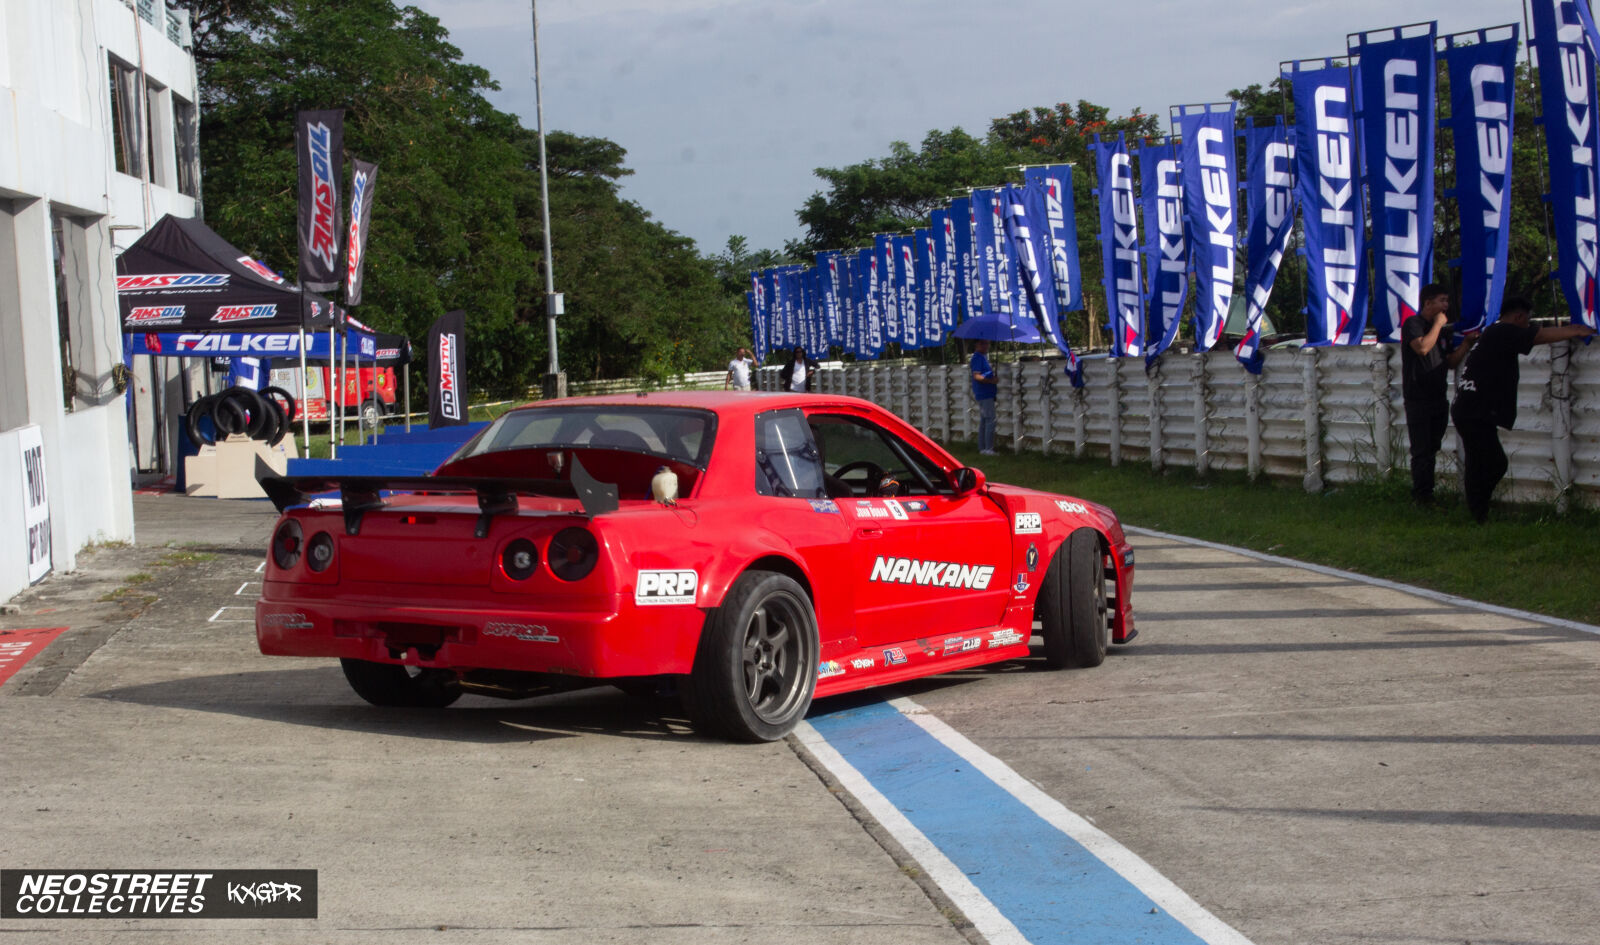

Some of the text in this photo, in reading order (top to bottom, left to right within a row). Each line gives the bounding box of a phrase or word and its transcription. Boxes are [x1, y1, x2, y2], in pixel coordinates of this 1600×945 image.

[307, 122, 337, 271] AMSOIL
[1314, 85, 1357, 347] FALKEN
[1384, 58, 1419, 340] FALKEN
[1046, 174, 1071, 306] FALKEN
[1111, 152, 1140, 357] FALKEN
[1197, 127, 1234, 349] FALKEN
[870, 255, 881, 349] FALKEN
[885, 241, 898, 339] FALKEN
[902, 245, 916, 346] FALKEN
[944, 217, 957, 327] FALKEN
[963, 252, 974, 318] ON THE PULSE
[986, 245, 999, 312] ON THE PULSE
[1018, 287, 1027, 318] PULSE
[126, 306, 185, 321] AMSOIL
[176, 334, 314, 351] FALKEN
[210, 304, 277, 323] AMSOIL
[24, 445, 45, 508] HOT
[1054, 500, 1089, 514] VENOM
[1015, 514, 1041, 529] PRP
[638, 572, 696, 596] PRP
[869, 556, 995, 590] NANKANG
[851, 659, 875, 669] VENOM
